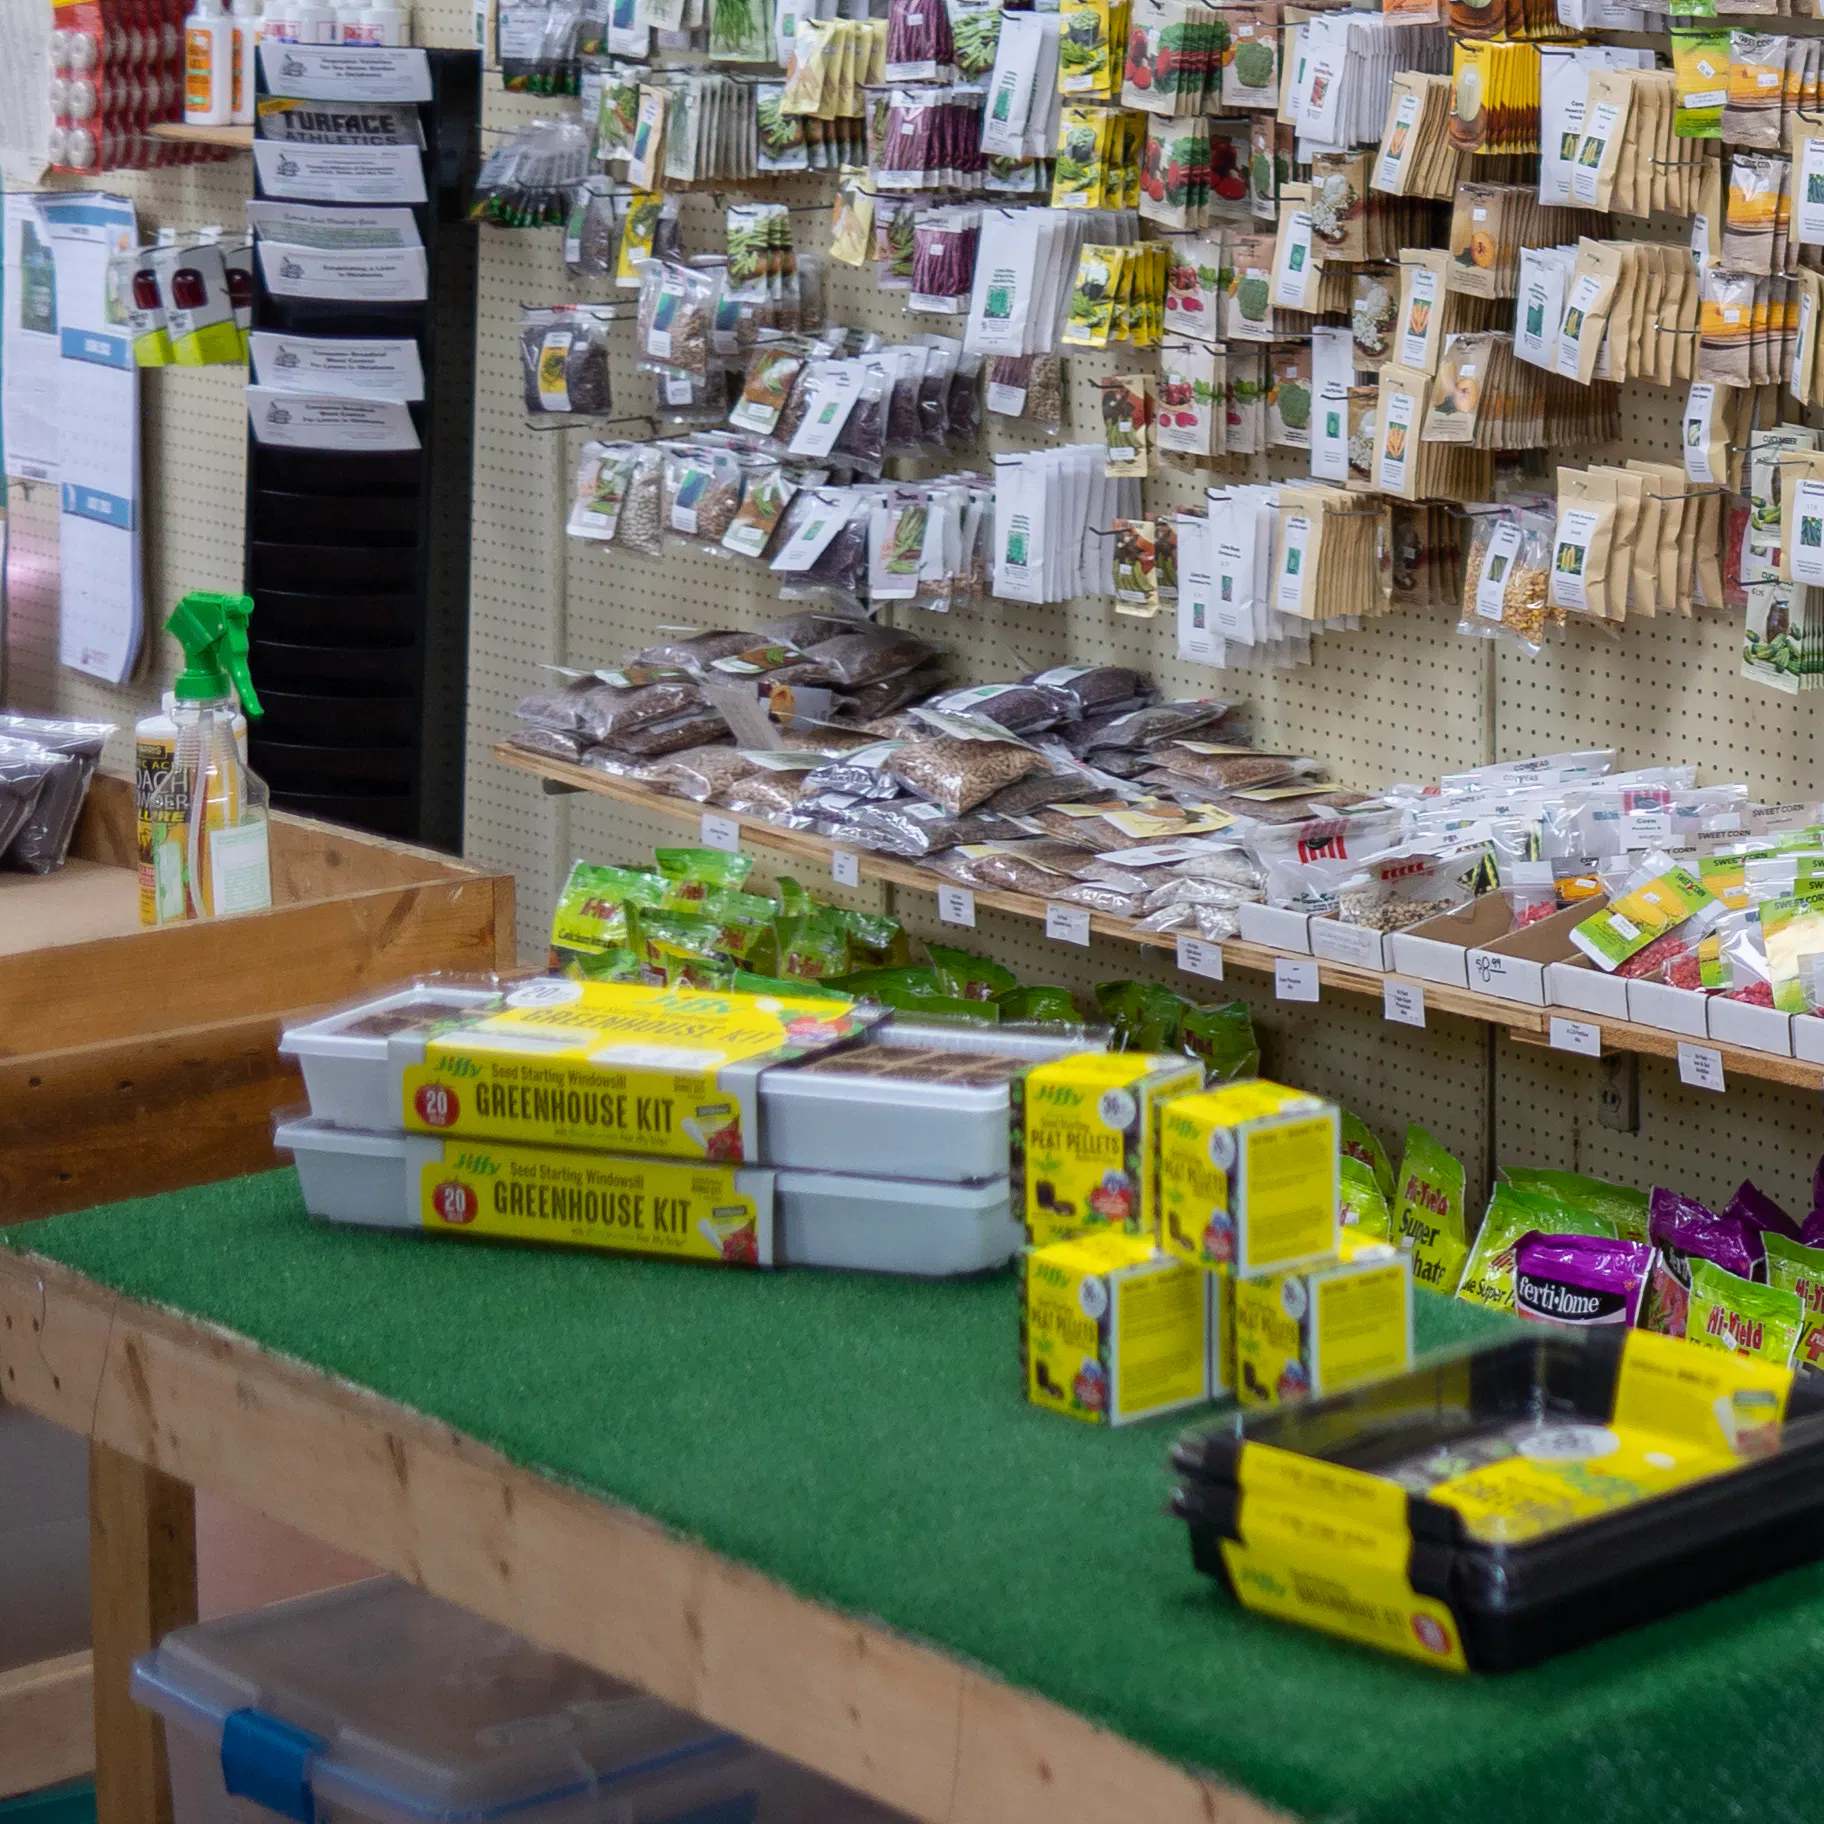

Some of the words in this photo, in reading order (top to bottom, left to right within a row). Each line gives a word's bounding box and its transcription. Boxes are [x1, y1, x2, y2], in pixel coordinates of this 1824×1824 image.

[285, 112, 395, 133] TURFACE
[285, 132, 398, 146] ATHLETICS
[1752, 806, 1781, 818] SWEET
[1781, 803, 1805, 816] CORN
[1697, 830, 1726, 840] SWEET
[1727, 828, 1752, 839] CORN
[433, 1055, 484, 1079] Jiffy
[491, 1063, 519, 1079] Seed
[521, 1065, 566, 1088] Starting
[567, 1070, 628, 1091] Windowsill
[426, 1089, 449, 1115] 20
[475, 1082, 628, 1130] GREENHOUSE
[636, 1096, 675, 1133] KIT
[1030, 1128, 1061, 1151] PEAT
[1066, 1130, 1120, 1155] PELLETS
[453, 1152, 503, 1176] Jiffy
[510, 1162, 537, 1178] Seed
[539, 1164, 584, 1187] Starting
[585, 1169, 645, 1190] Windowsill
[443, 1188, 466, 1214] 20
[493, 1181, 645, 1230] GREENHOUSE
[653, 1196, 692, 1234] KIT
[1404, 1175, 1449, 1217] Hi-Yield
[1399, 1208, 1441, 1249] Super
